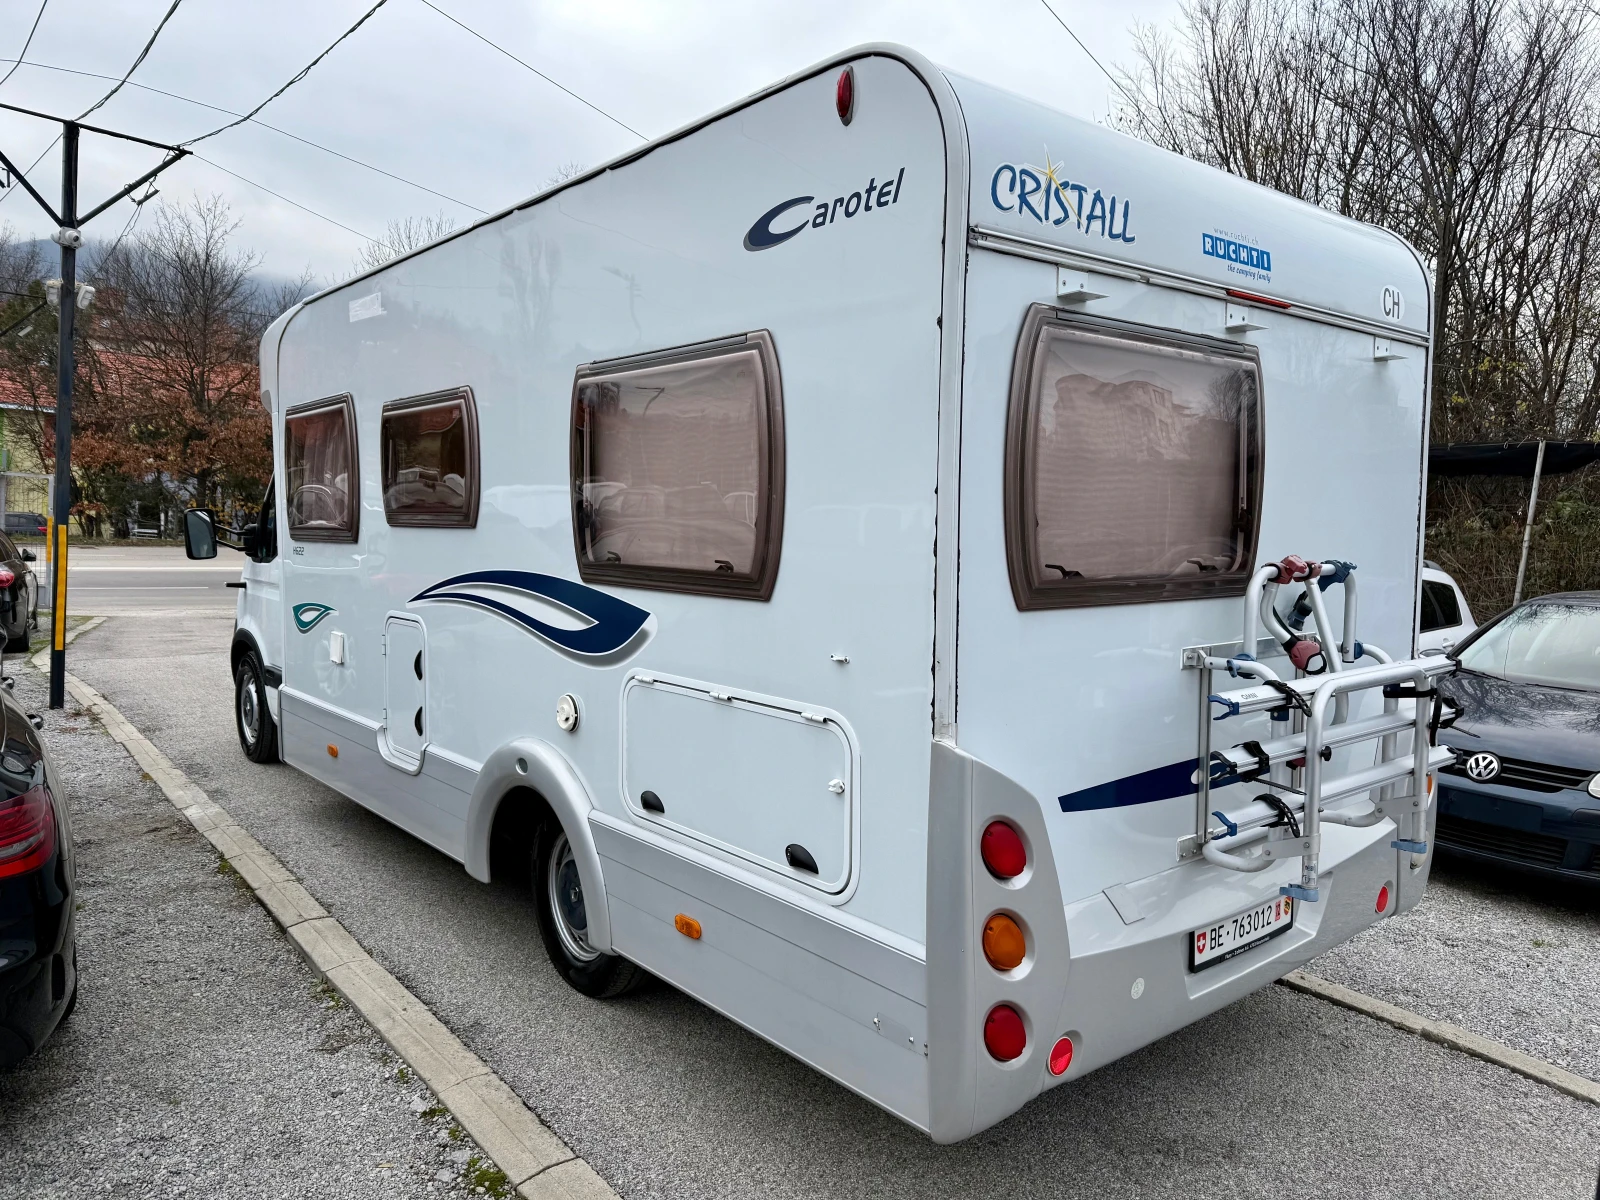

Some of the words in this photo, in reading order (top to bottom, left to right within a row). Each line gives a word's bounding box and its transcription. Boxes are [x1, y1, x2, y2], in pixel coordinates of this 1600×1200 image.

[743, 167, 905, 252] Carotel
[990, 164, 1136, 243] CRISTALL
[1203, 235, 1269, 269] RUCHTI
[1383, 287, 1400, 320] CH
